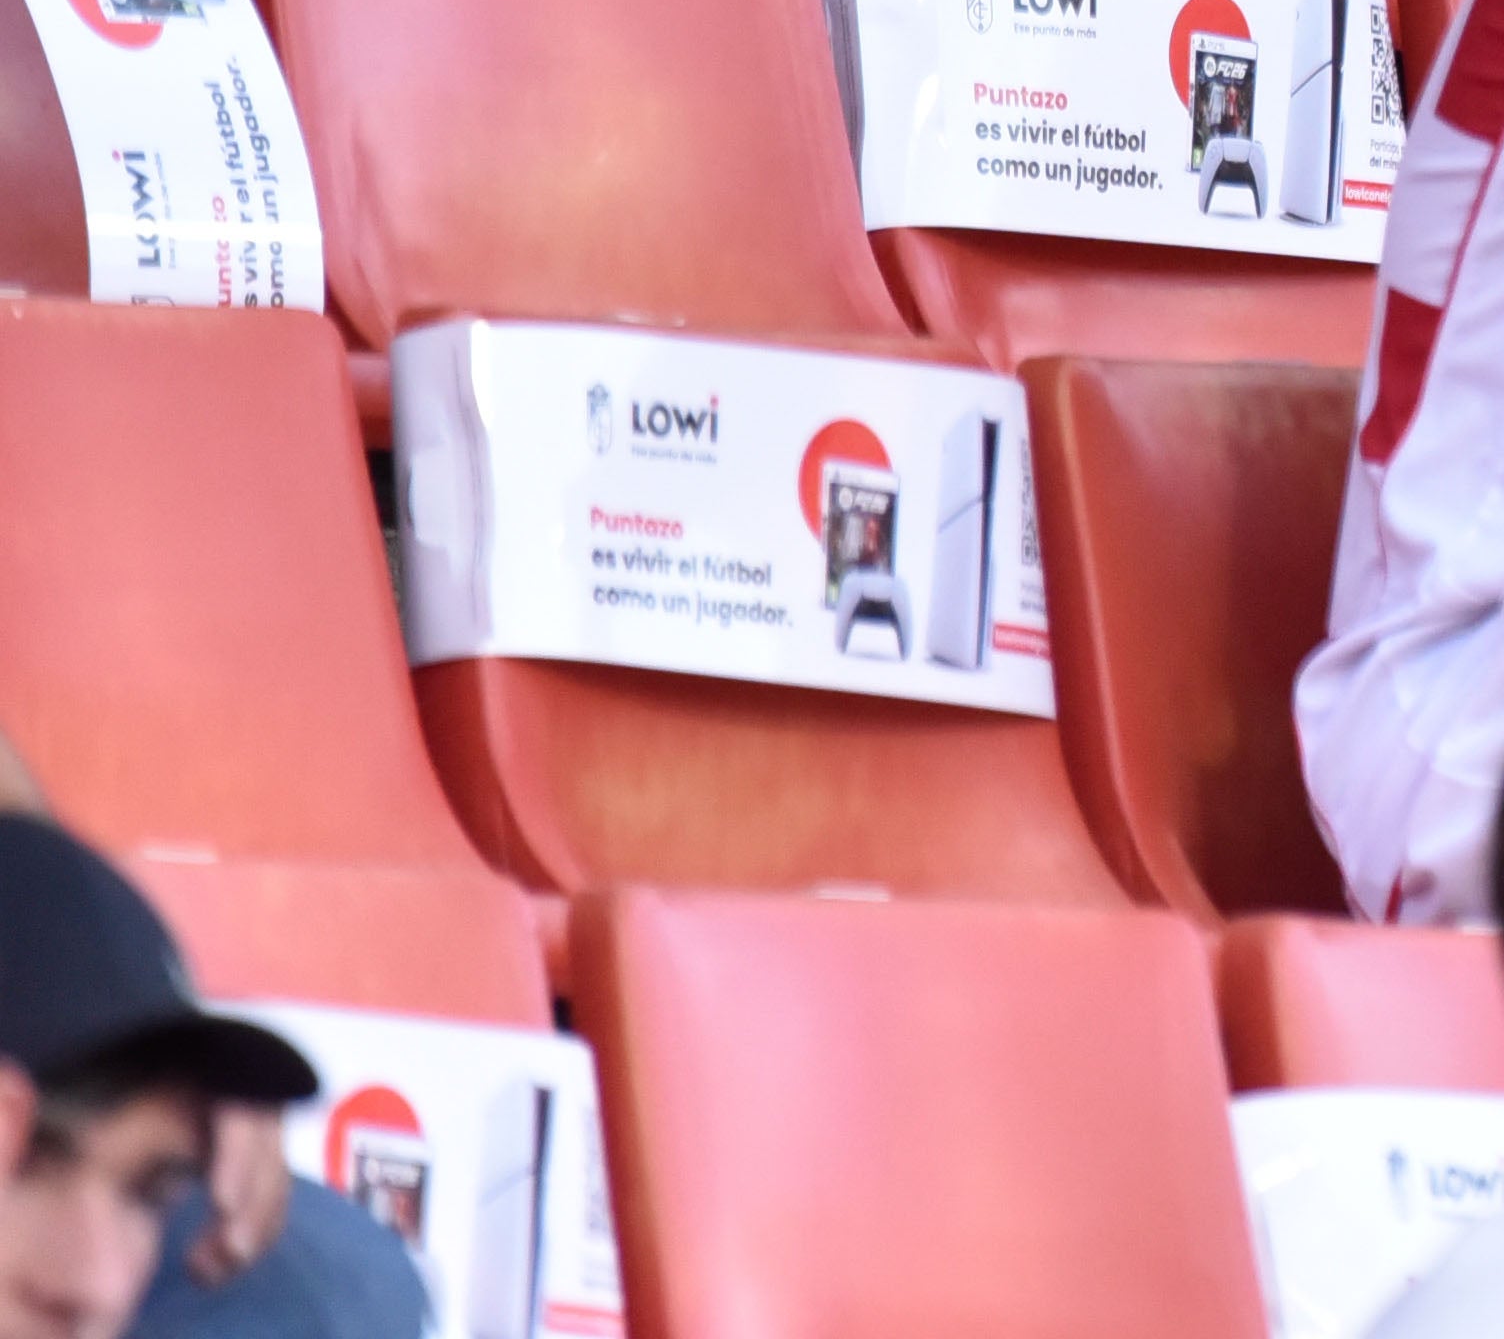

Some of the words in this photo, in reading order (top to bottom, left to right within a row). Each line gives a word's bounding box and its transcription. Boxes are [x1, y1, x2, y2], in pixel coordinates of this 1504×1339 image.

[1014, 23, 1031, 34] Ese
[1033, 24, 1061, 37] punto
[1063, 26, 1075, 37] de
[973, 82, 1068, 111] Puntazo
[975, 120, 1001, 141] es
[1007, 117, 1058, 146] vivir
[1061, 123, 1080, 148] el
[1084, 123, 1147, 154] fútbol
[976, 156, 1041, 181] como
[1045, 162, 1072, 183] un
[1075, 157, 1164, 193] jugador.
[590, 506, 684, 539] Puntazo
[591, 547, 616, 569] es
[622, 546, 673, 576] vivir
[678, 555, 698, 579] el
[703, 554, 773, 588] fútbol
[592, 584, 657, 610] como
[661, 593, 691, 615] un
[695, 591, 794, 630] jugador.
